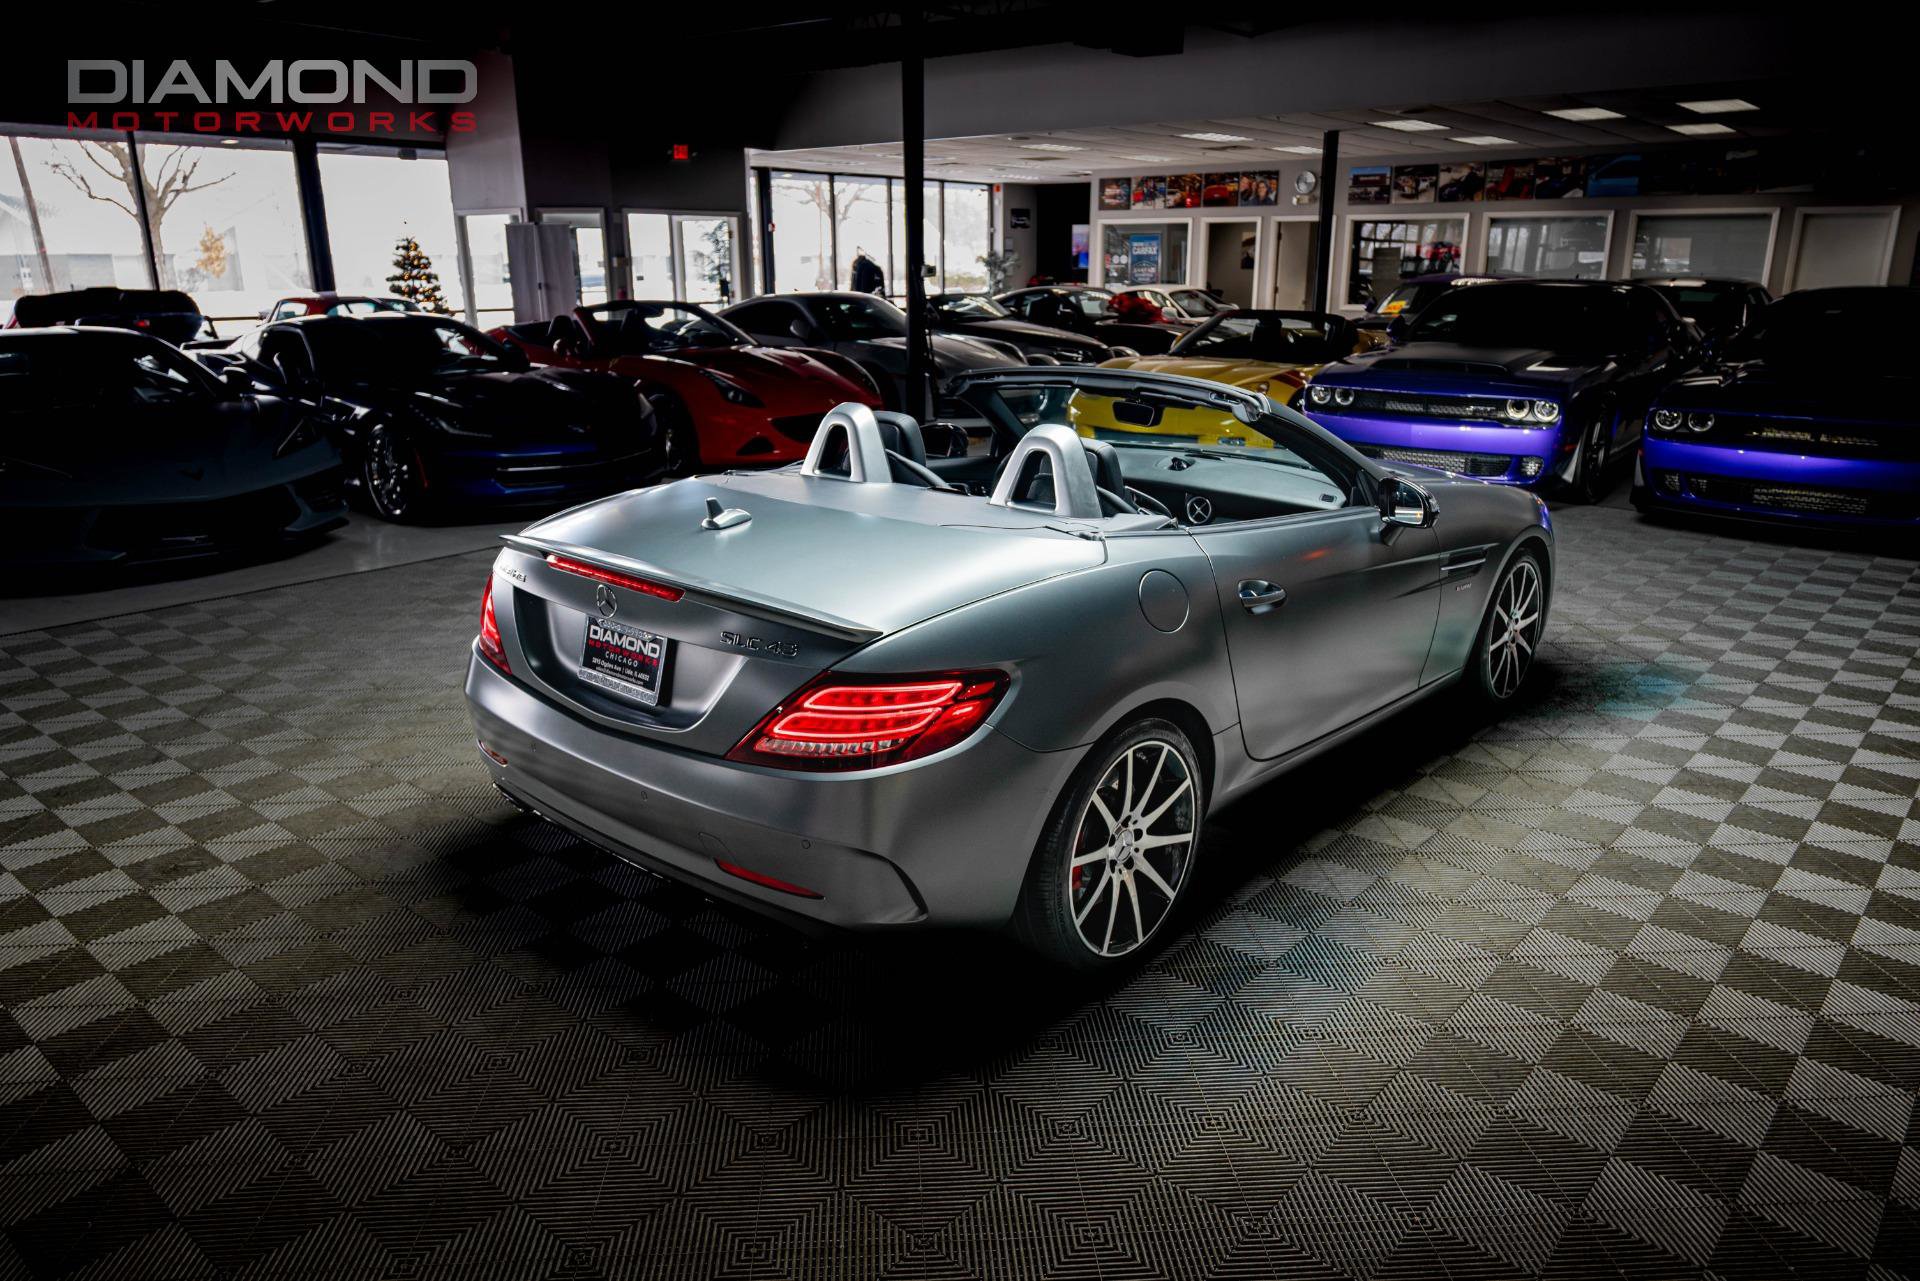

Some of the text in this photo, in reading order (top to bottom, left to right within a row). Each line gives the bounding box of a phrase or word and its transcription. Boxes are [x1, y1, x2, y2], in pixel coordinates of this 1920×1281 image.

[588, 640, 658, 667] MOTORWORKS
[590, 625, 660, 658] DIAMOND
[720, 631, 799, 657] SLC 43
[605, 651, 638, 667] CHICAGO
